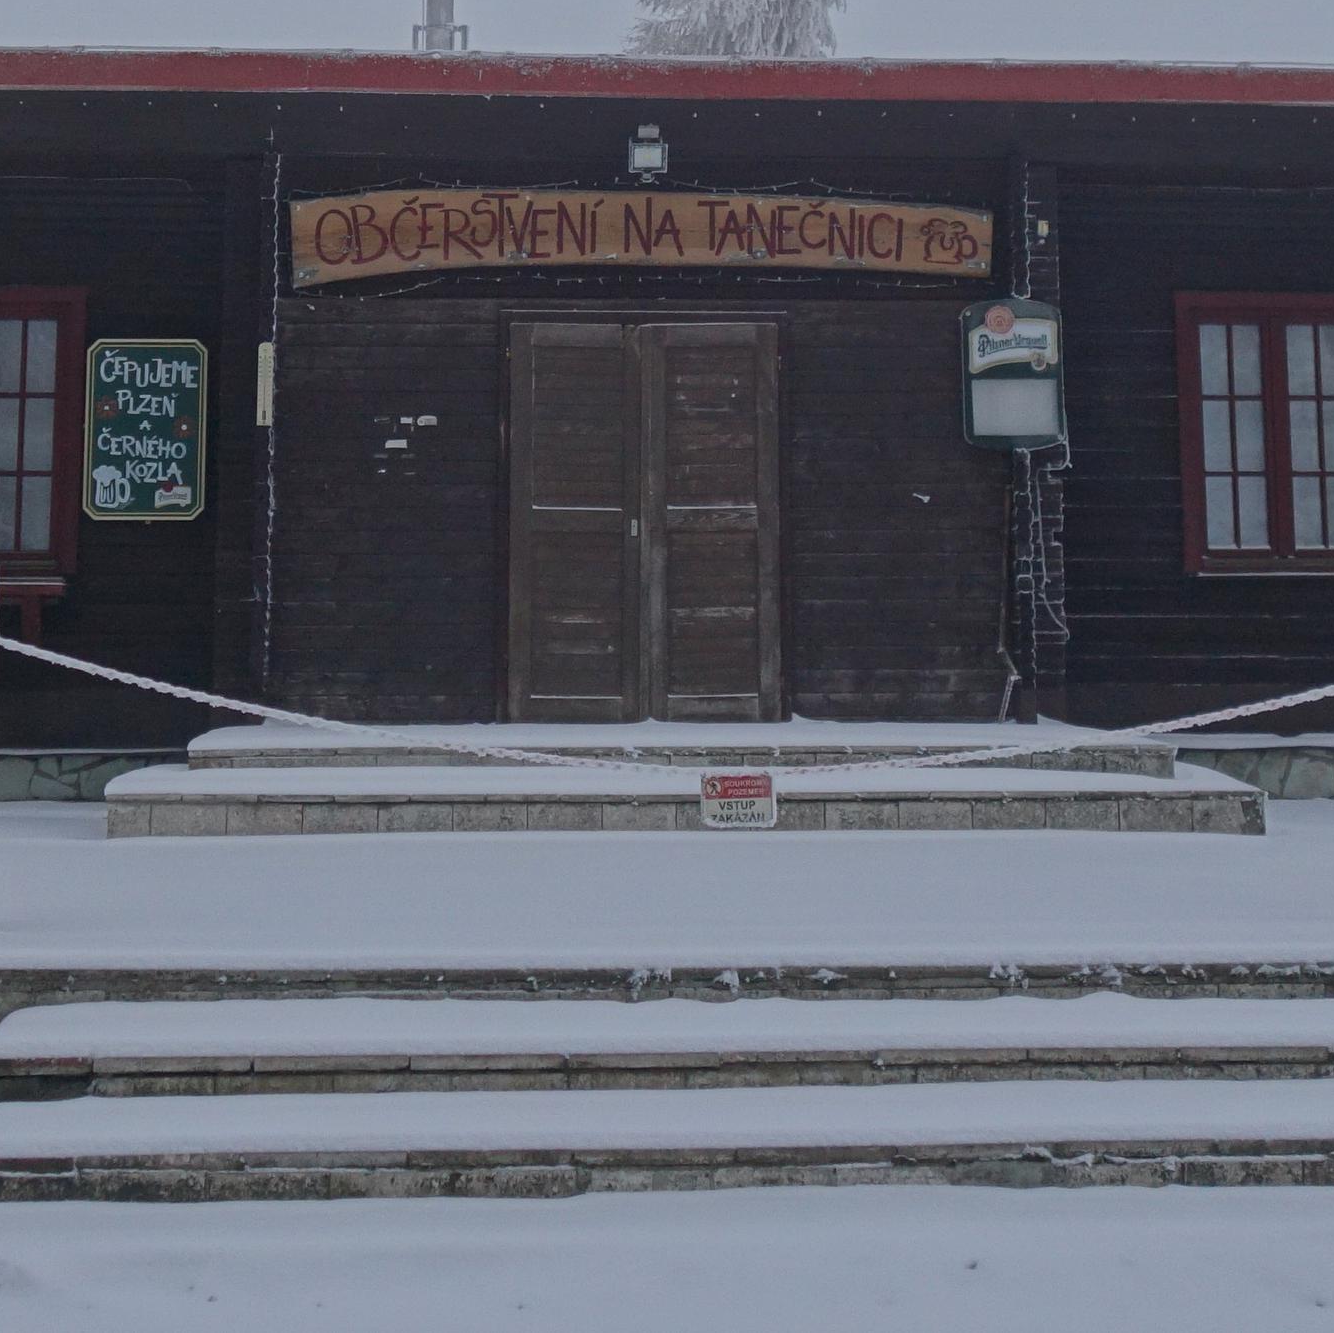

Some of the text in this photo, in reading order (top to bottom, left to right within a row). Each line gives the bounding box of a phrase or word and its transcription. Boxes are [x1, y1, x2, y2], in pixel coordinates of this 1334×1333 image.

[315, 193, 905, 265] OBČERSTVENÍ NA TANEČNICI
[978, 334, 1013, 358] Pilsner
[99, 349, 198, 388] ČEPUJEME
[116, 389, 179, 417] PLZEŇ
[139, 419, 152, 431] A
[97, 427, 187, 459] ČERNÉHO
[125, 460, 183, 485] KOZLA
[718, 800, 756, 811] VSTUP
